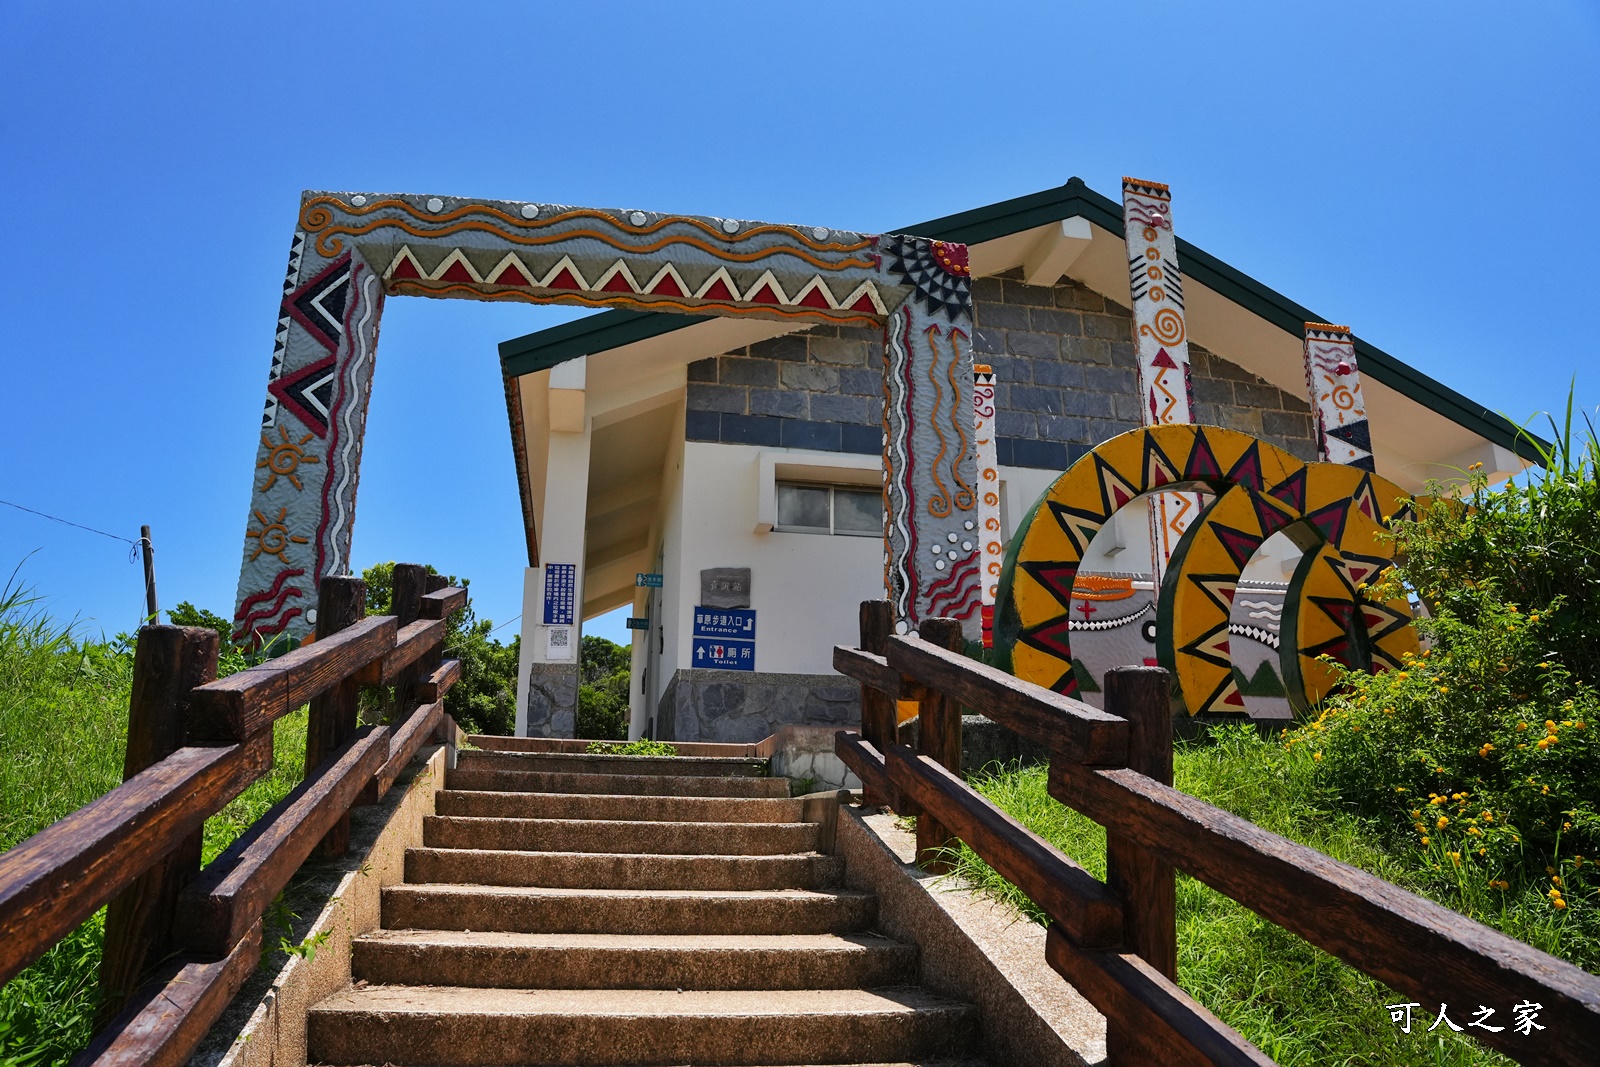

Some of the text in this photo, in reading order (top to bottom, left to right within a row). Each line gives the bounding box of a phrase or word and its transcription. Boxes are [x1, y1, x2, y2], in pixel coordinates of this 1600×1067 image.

[697, 614, 742, 626] 草原步道入口
[727, 647, 751, 659] 廁所
